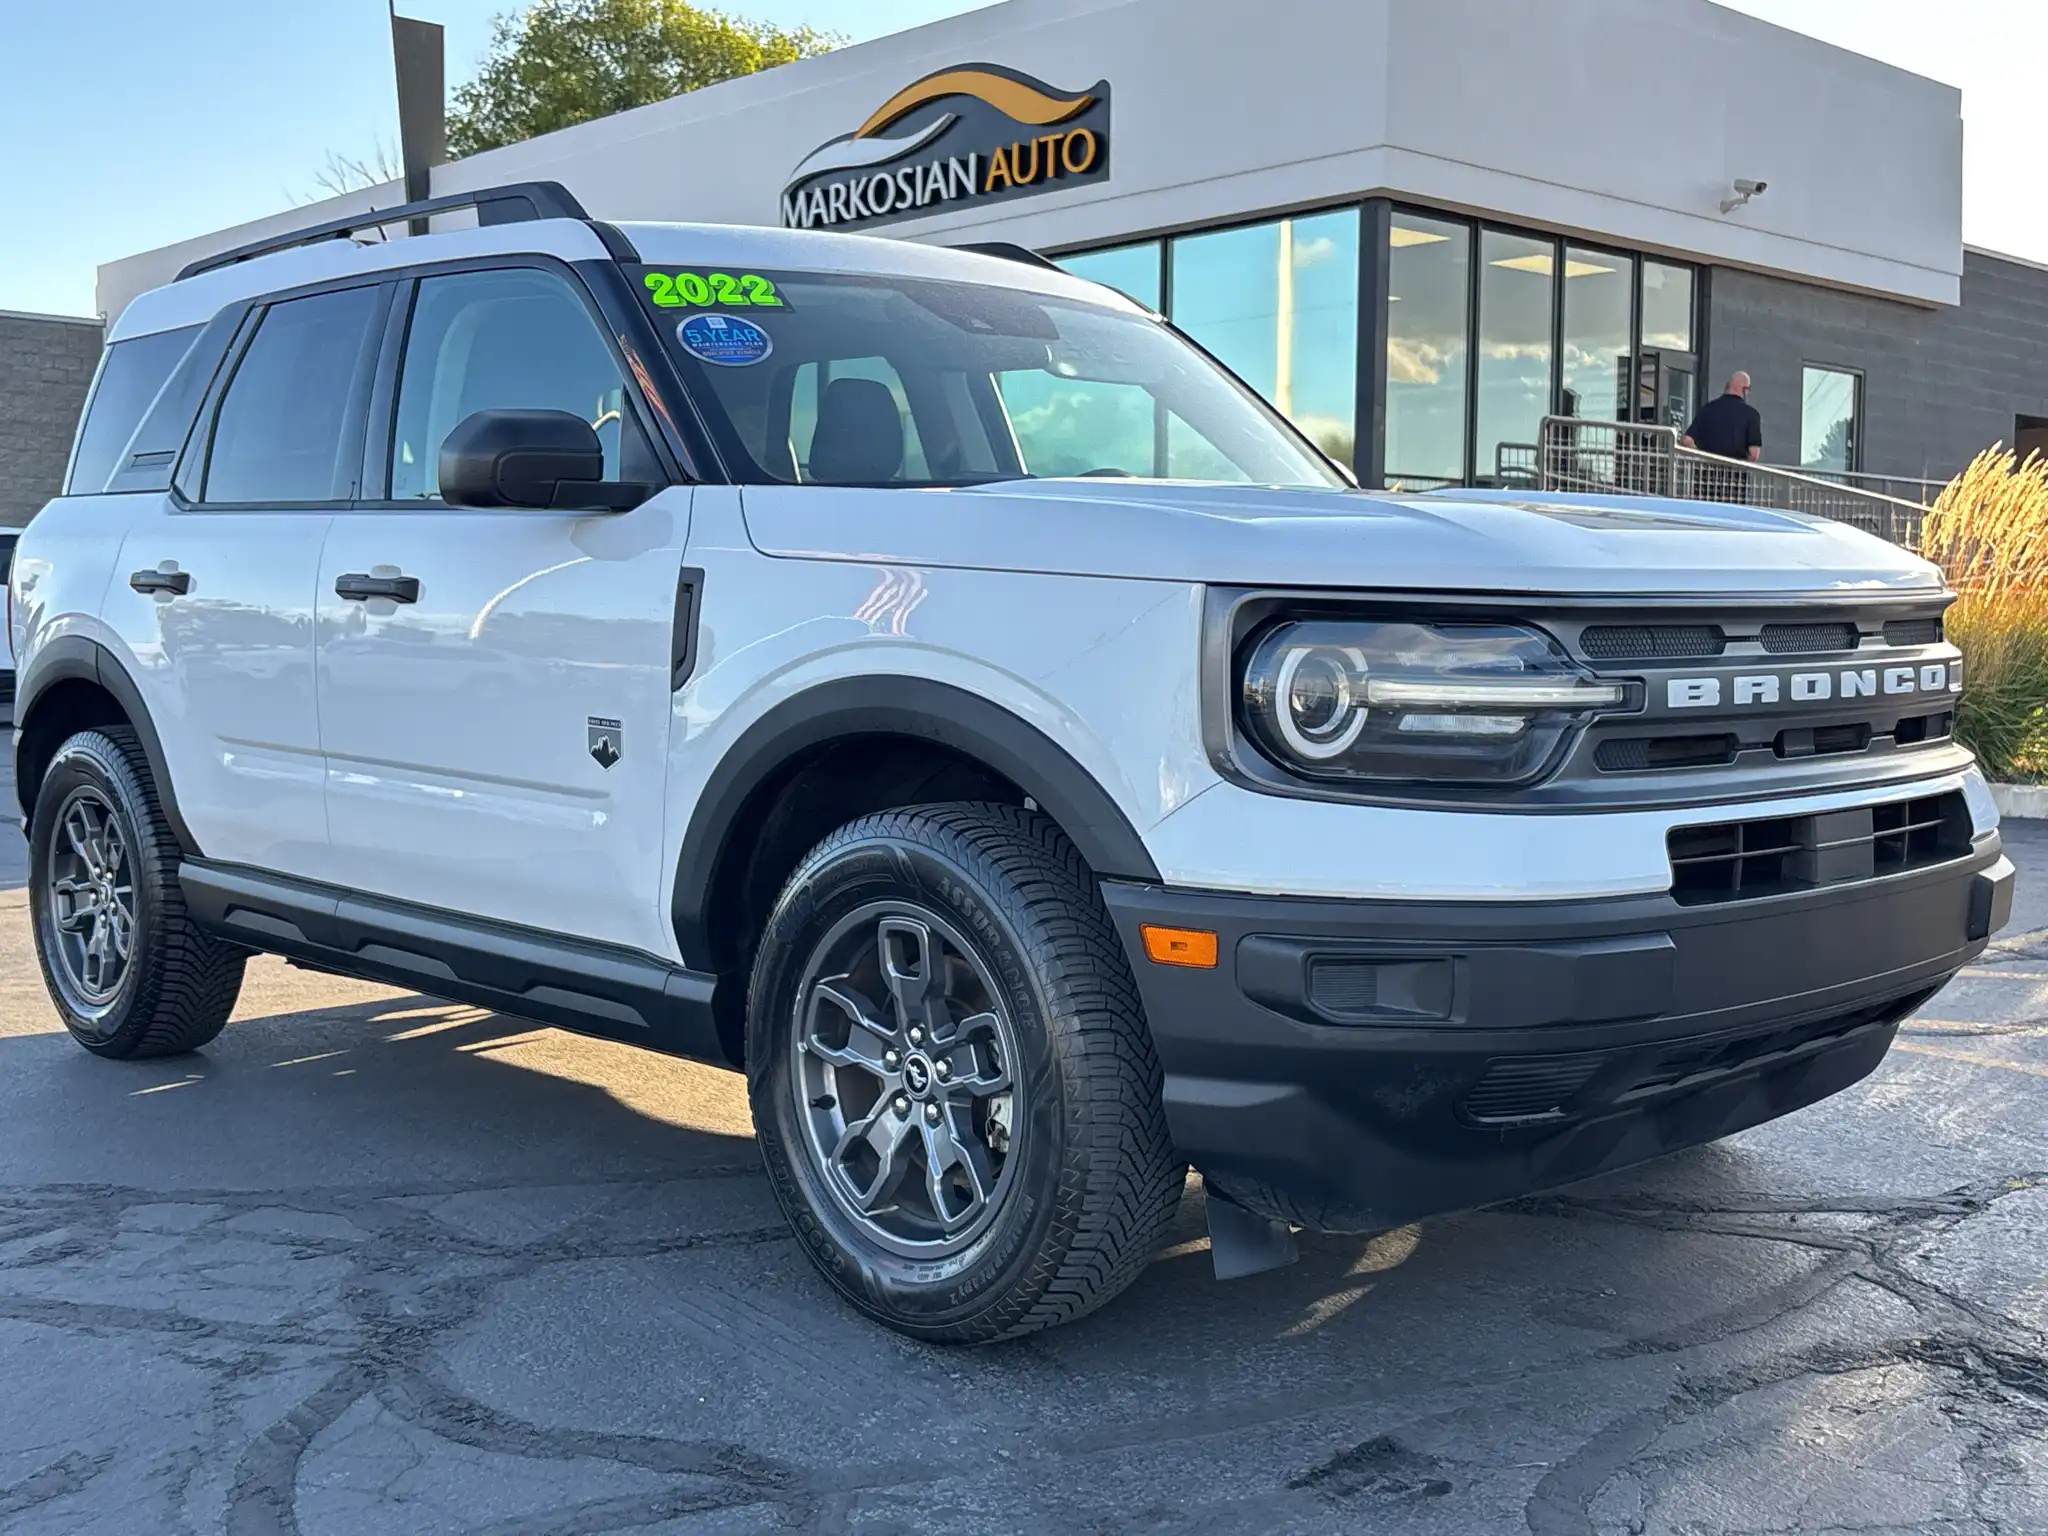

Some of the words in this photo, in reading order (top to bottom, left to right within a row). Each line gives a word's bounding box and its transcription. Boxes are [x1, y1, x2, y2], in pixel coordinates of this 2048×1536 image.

[781, 152, 977, 229] MARKOSIAN
[985, 127, 1097, 192] AUTO
[644, 272, 784, 308] 2022
[685, 329, 702, 343] 5
[703, 328, 762, 342] YEAR
[1667, 663, 1946, 708] BRONCO
